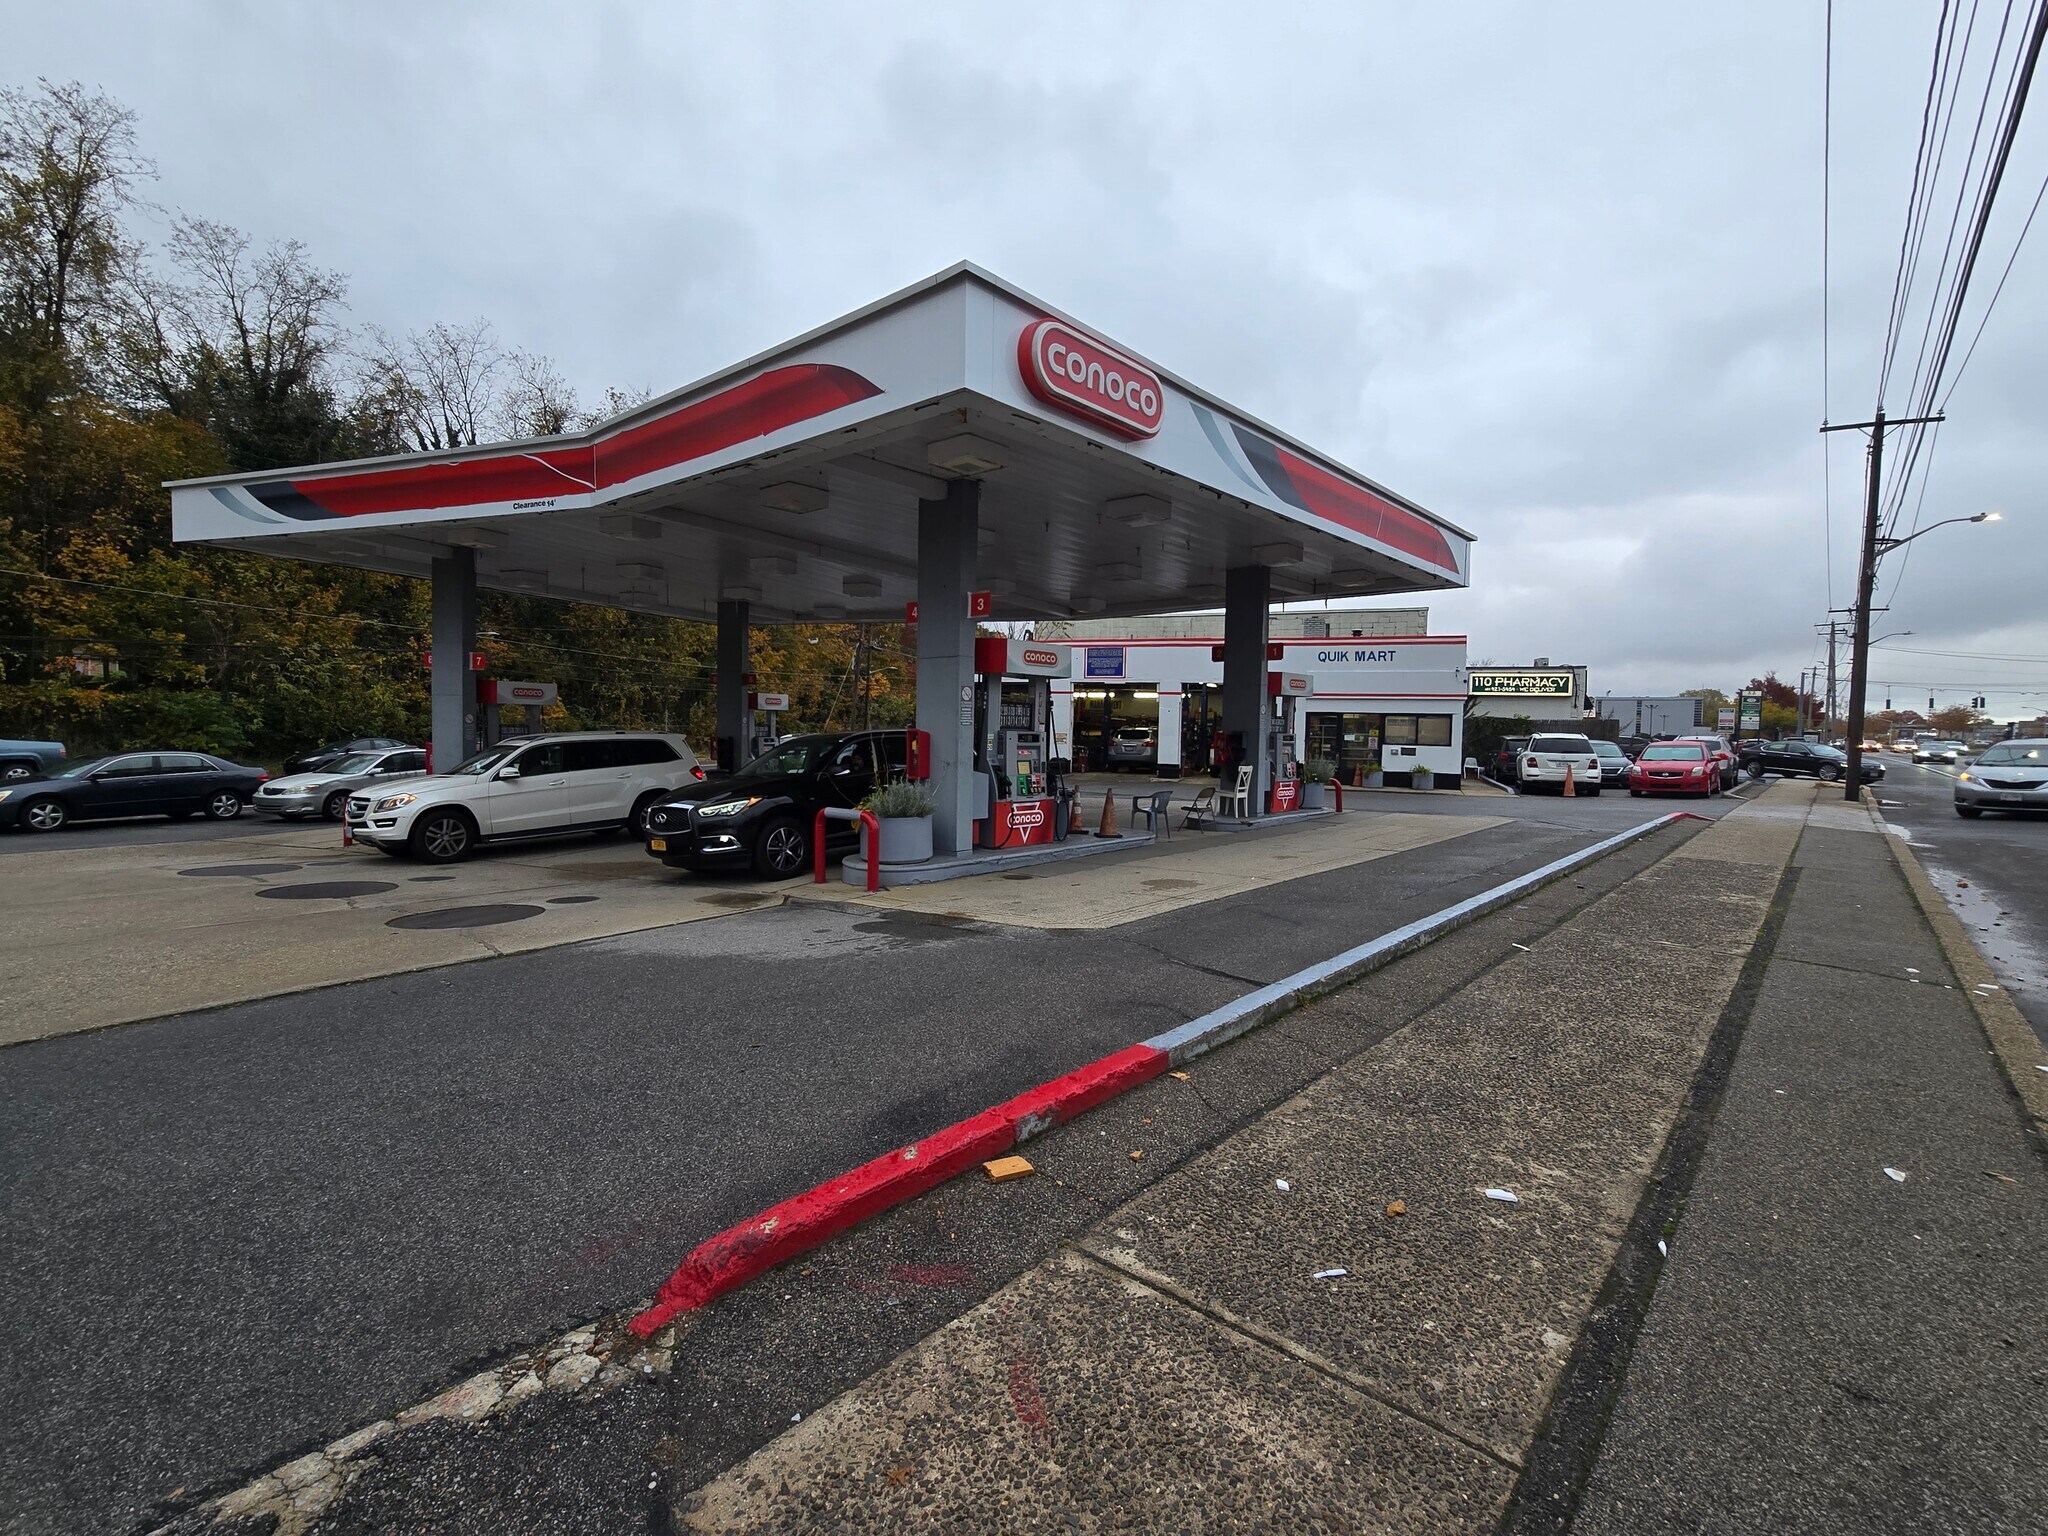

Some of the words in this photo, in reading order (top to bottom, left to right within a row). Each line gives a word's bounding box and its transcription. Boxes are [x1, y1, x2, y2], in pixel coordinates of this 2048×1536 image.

[1047, 342, 1158, 417] CONOCO
[512, 500, 546, 510] Clearance
[977, 598, 984, 611] 3
[911, 606, 918, 618] 4
[1272, 647, 1277, 657] 1
[1317, 650, 1350, 663] QUIK
[1354, 650, 1397, 662] MART
[476, 656, 482, 666] 7
[1025, 652, 1056, 663] CONOCO
[1474, 677, 1492, 687] 110
[1494, 677, 1567, 687] PHARMACY
[513, 688, 543, 696] CONOCO
